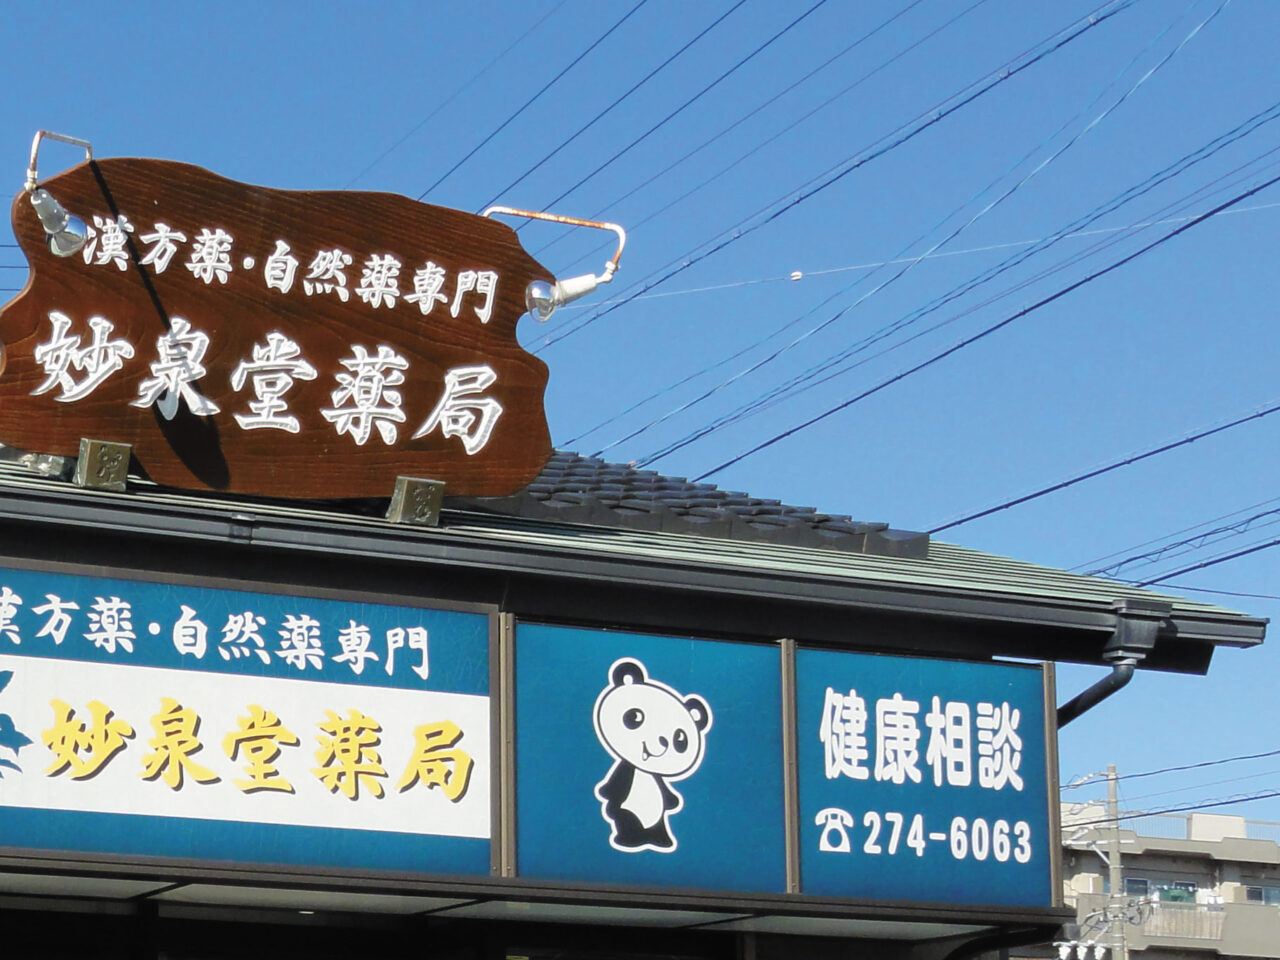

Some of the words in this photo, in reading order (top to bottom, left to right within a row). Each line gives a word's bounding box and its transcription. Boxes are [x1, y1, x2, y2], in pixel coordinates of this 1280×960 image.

[83, 214, 498, 324] 漢方薬・自然薬専門
[30, 311, 503, 455] 妙泉堂薬局
[40, 698, 475, 802] 妙泉堂薬局
[819, 687, 1024, 792] 健康相談
[863, 812, 1033, 864] 274-6063
